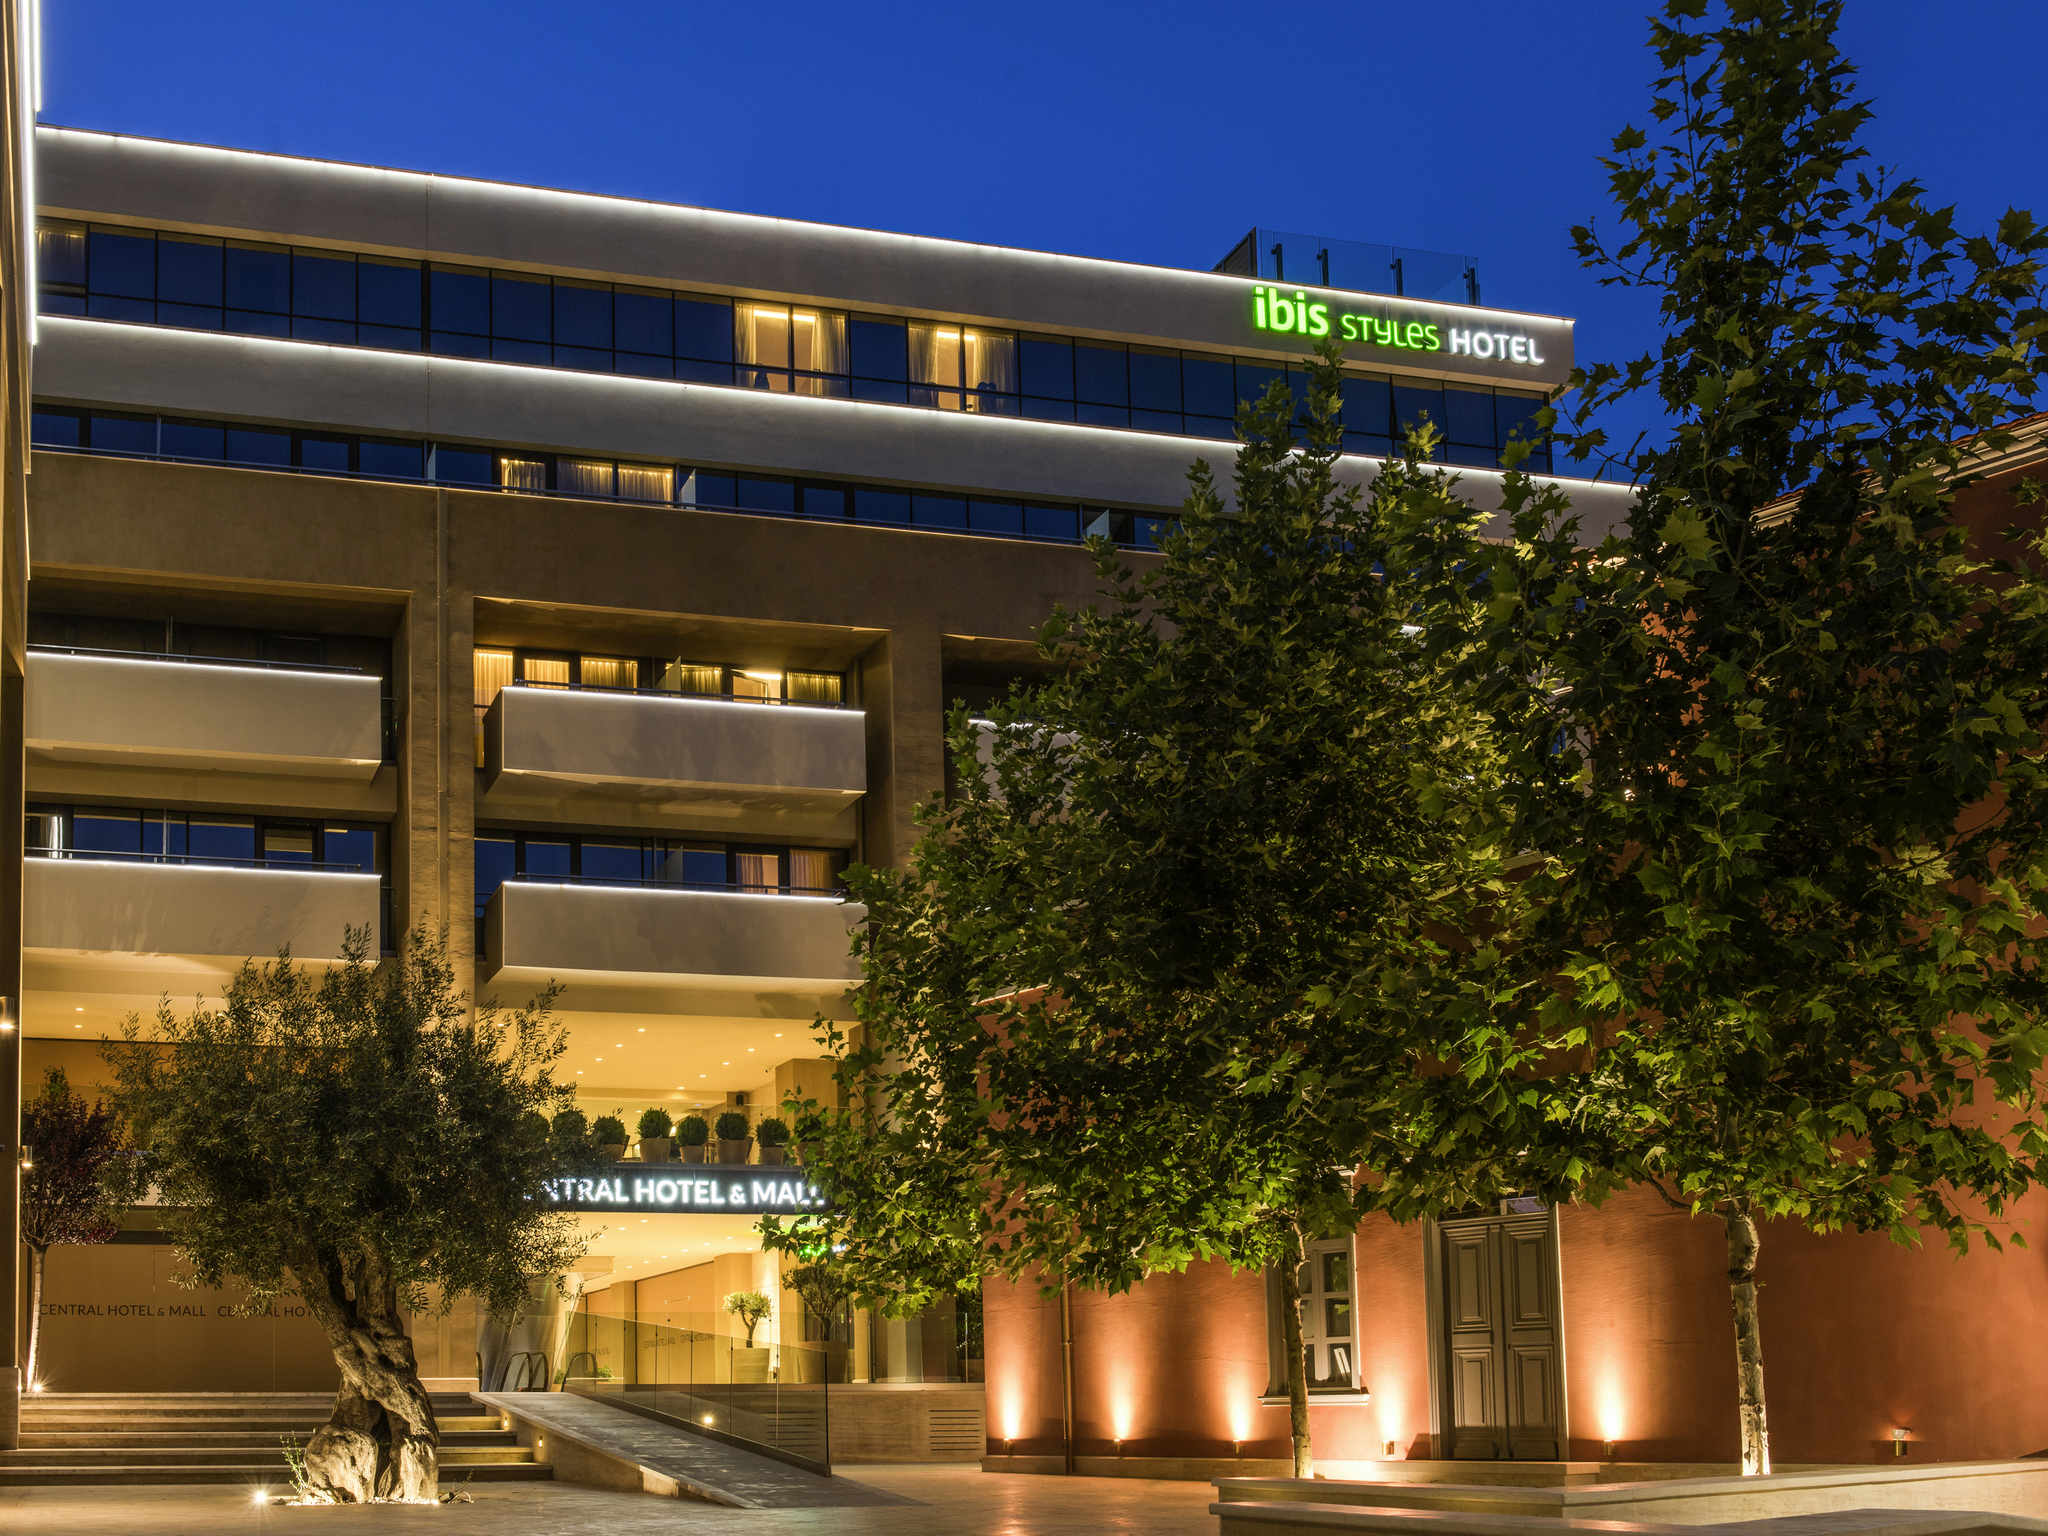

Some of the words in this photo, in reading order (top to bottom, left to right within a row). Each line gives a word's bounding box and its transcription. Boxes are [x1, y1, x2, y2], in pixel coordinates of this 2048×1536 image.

[1253, 286, 1329, 336] ibis
[1450, 327, 1545, 367] HOTEL
[634, 1178, 725, 1205] HOTEL
[730, 1183, 746, 1204] &
[39, 1303, 104, 1316] CENTRAL
[107, 1304, 154, 1317] HOTEL
[168, 1304, 207, 1317] MALL
